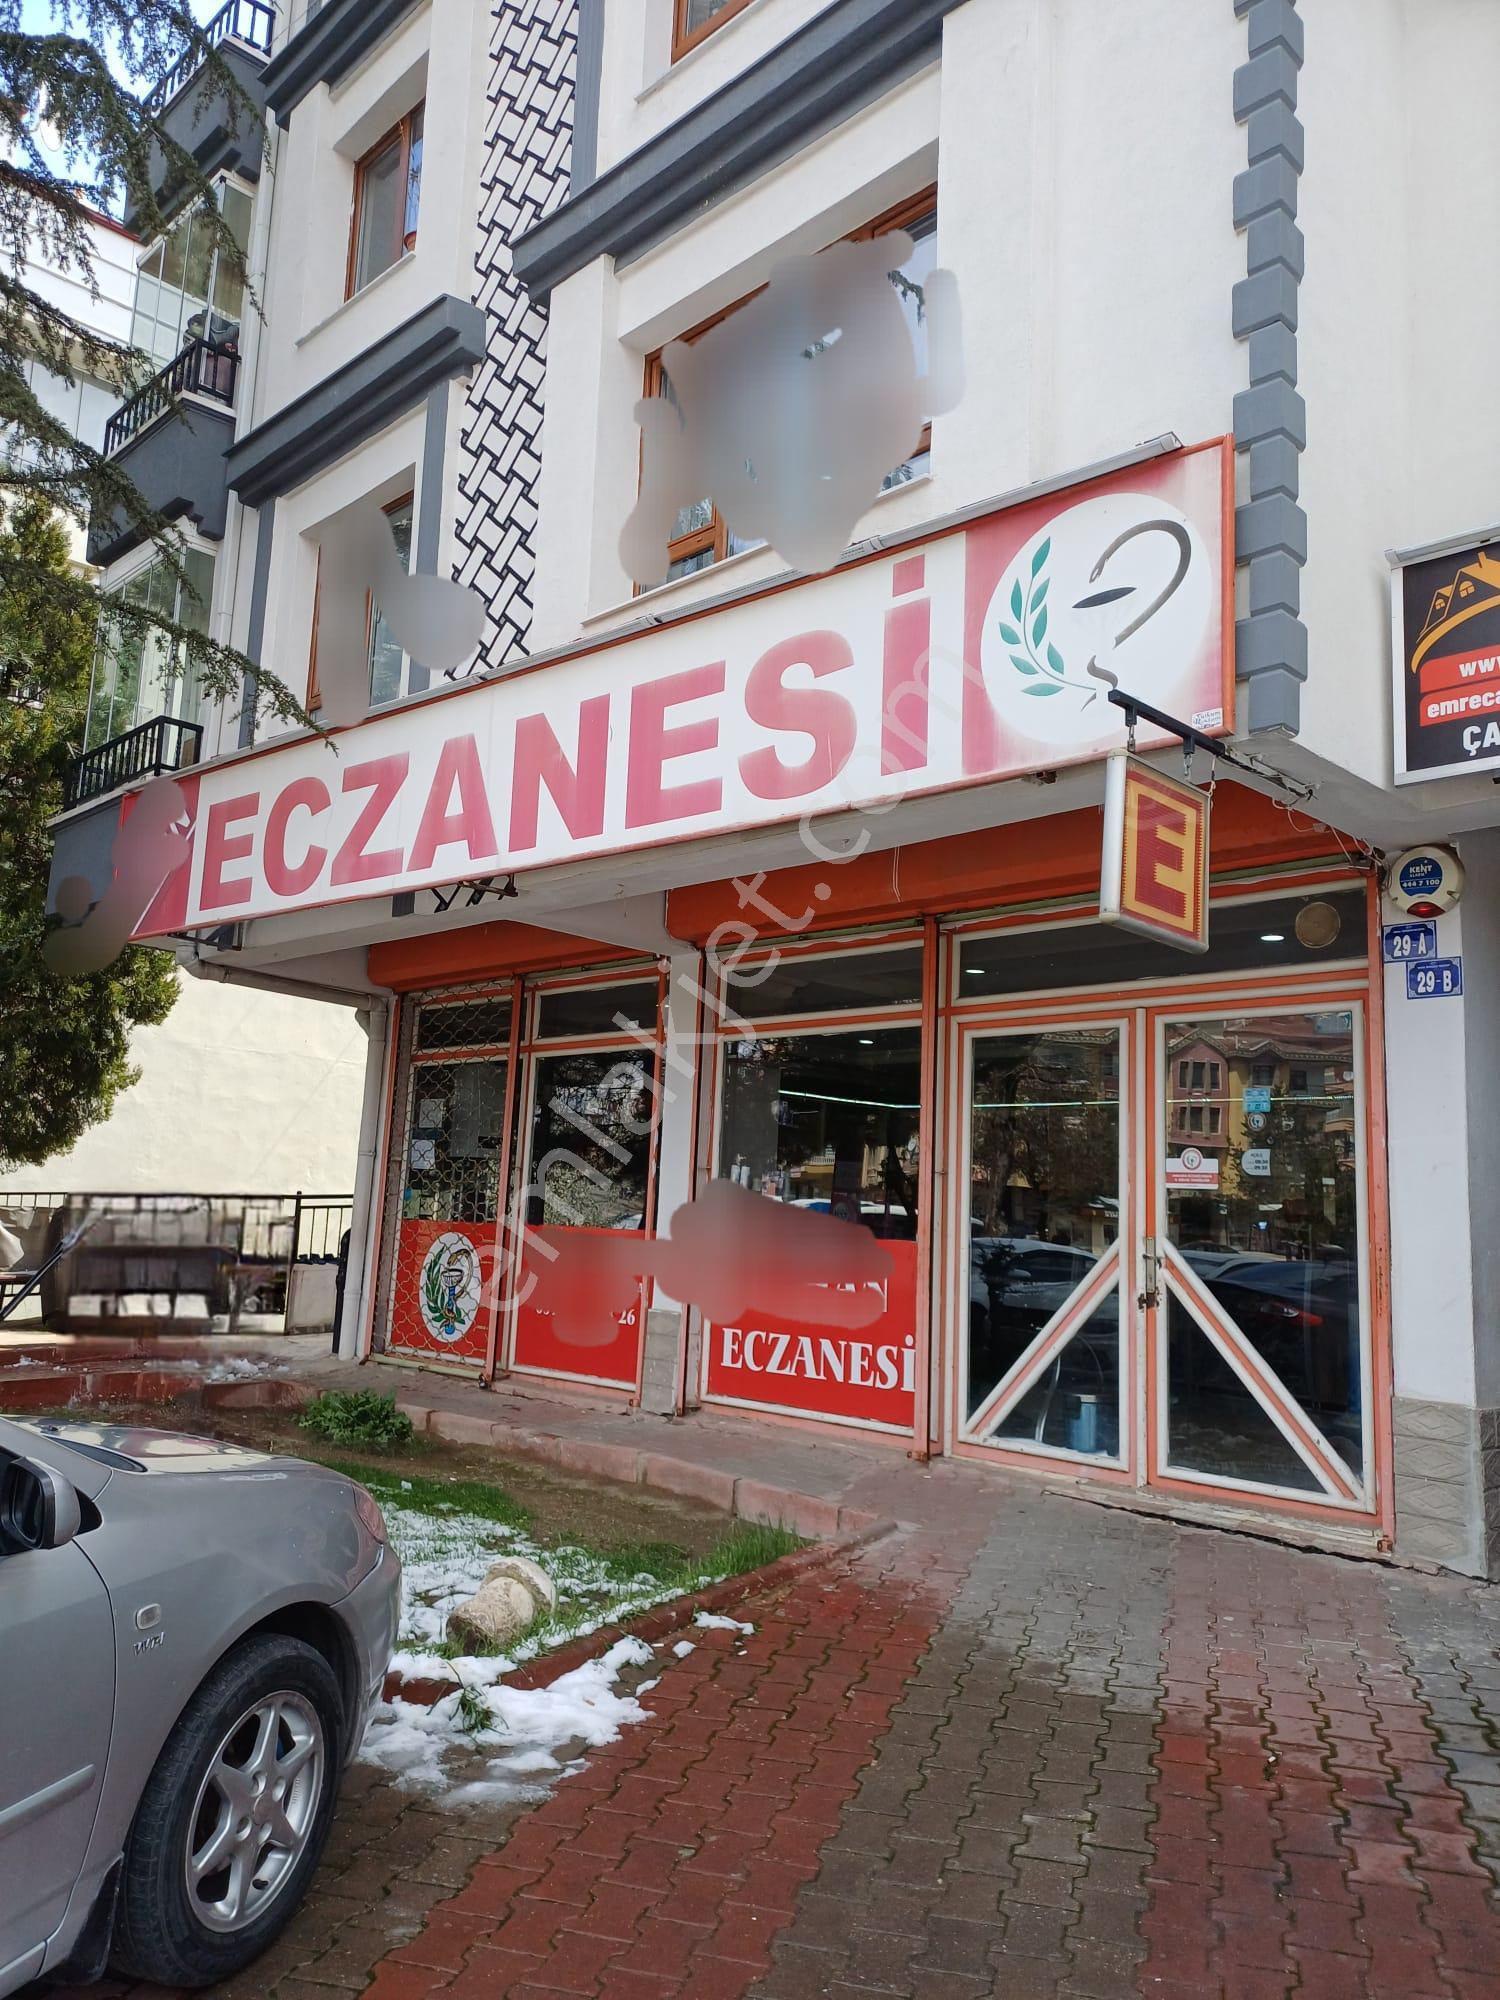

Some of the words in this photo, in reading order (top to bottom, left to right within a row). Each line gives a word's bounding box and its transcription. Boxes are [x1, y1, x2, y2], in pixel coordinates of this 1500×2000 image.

[1459, 655, 1500, 678] ww
[1427, 690, 1500, 718] emrec
[199, 554, 930, 912] ECZANESİ
[1409, 864, 1433, 875] KENT
[721, 1327, 916, 1392] ECZANESİ
